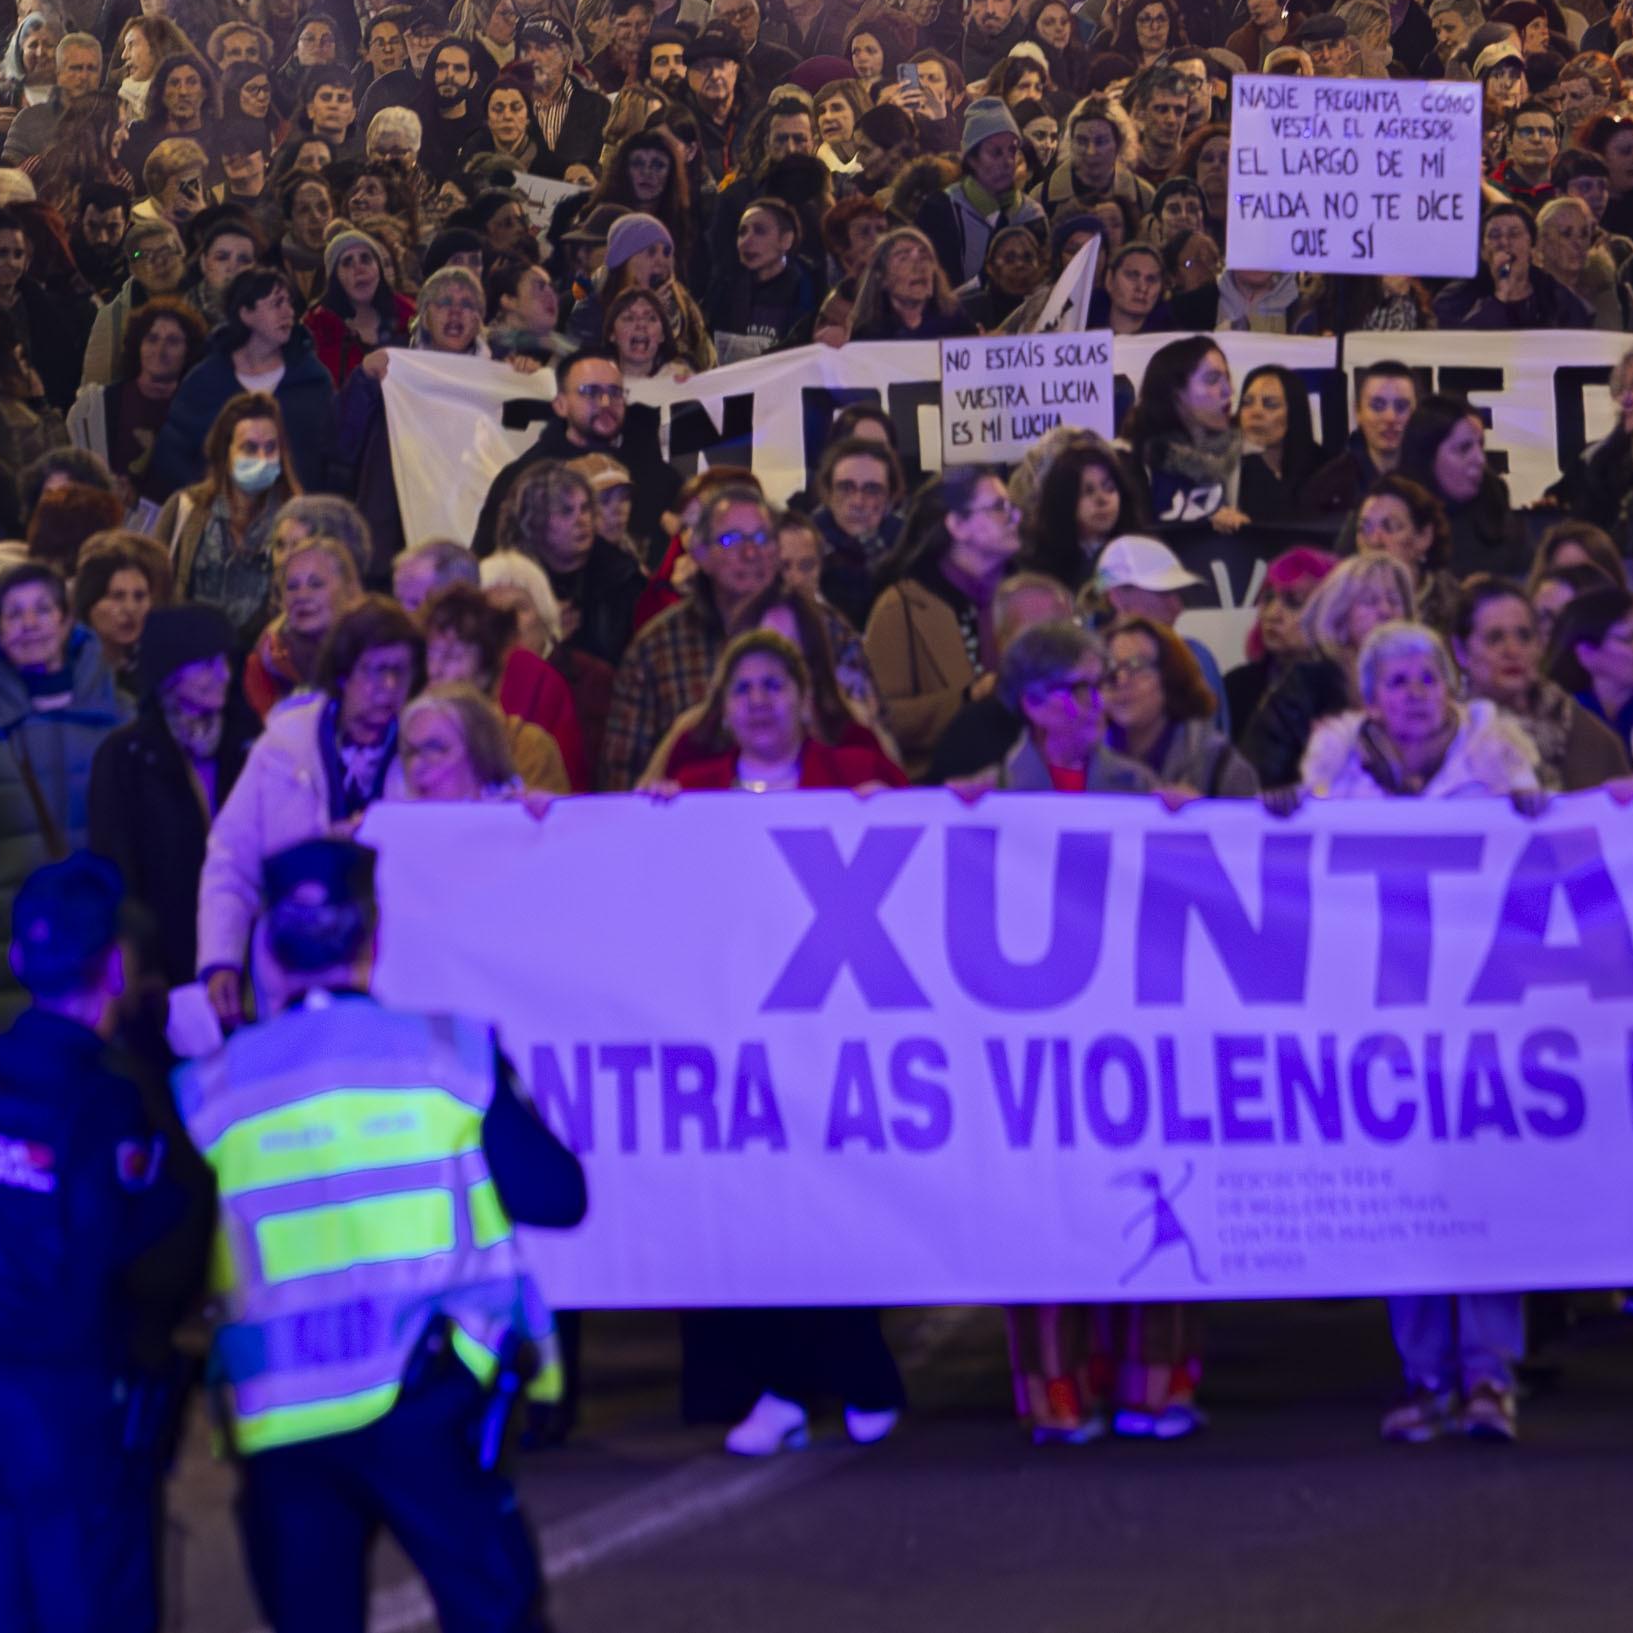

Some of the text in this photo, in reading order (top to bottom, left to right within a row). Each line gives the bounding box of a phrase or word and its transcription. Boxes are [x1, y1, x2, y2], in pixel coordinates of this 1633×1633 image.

[1315, 88, 1401, 114] PREGUNTA
[1343, 118, 1364, 138] EL
[1374, 118, 1456, 141] AGRESOR
[1237, 148, 1268, 175] EL
[1282, 147, 1359, 176] LARGO
[1377, 151, 1403, 178] DE
[1239, 191, 1309, 219] FALDA
[1324, 192, 1358, 219] NO
[1371, 194, 1400, 220] TE
[1291, 228, 1328, 257] QUE
[946, 349, 971, 372] NO
[1055, 343, 1108, 367] SOLAS
[955, 380, 1099, 410] VUESTRA LUCHA
[951, 421, 973, 446] ES
[530, 1041, 790, 1156] NTRA
[823, 1036, 954, 1155] AS
[984, 1026, 1588, 1151] VIOLENCIAS
